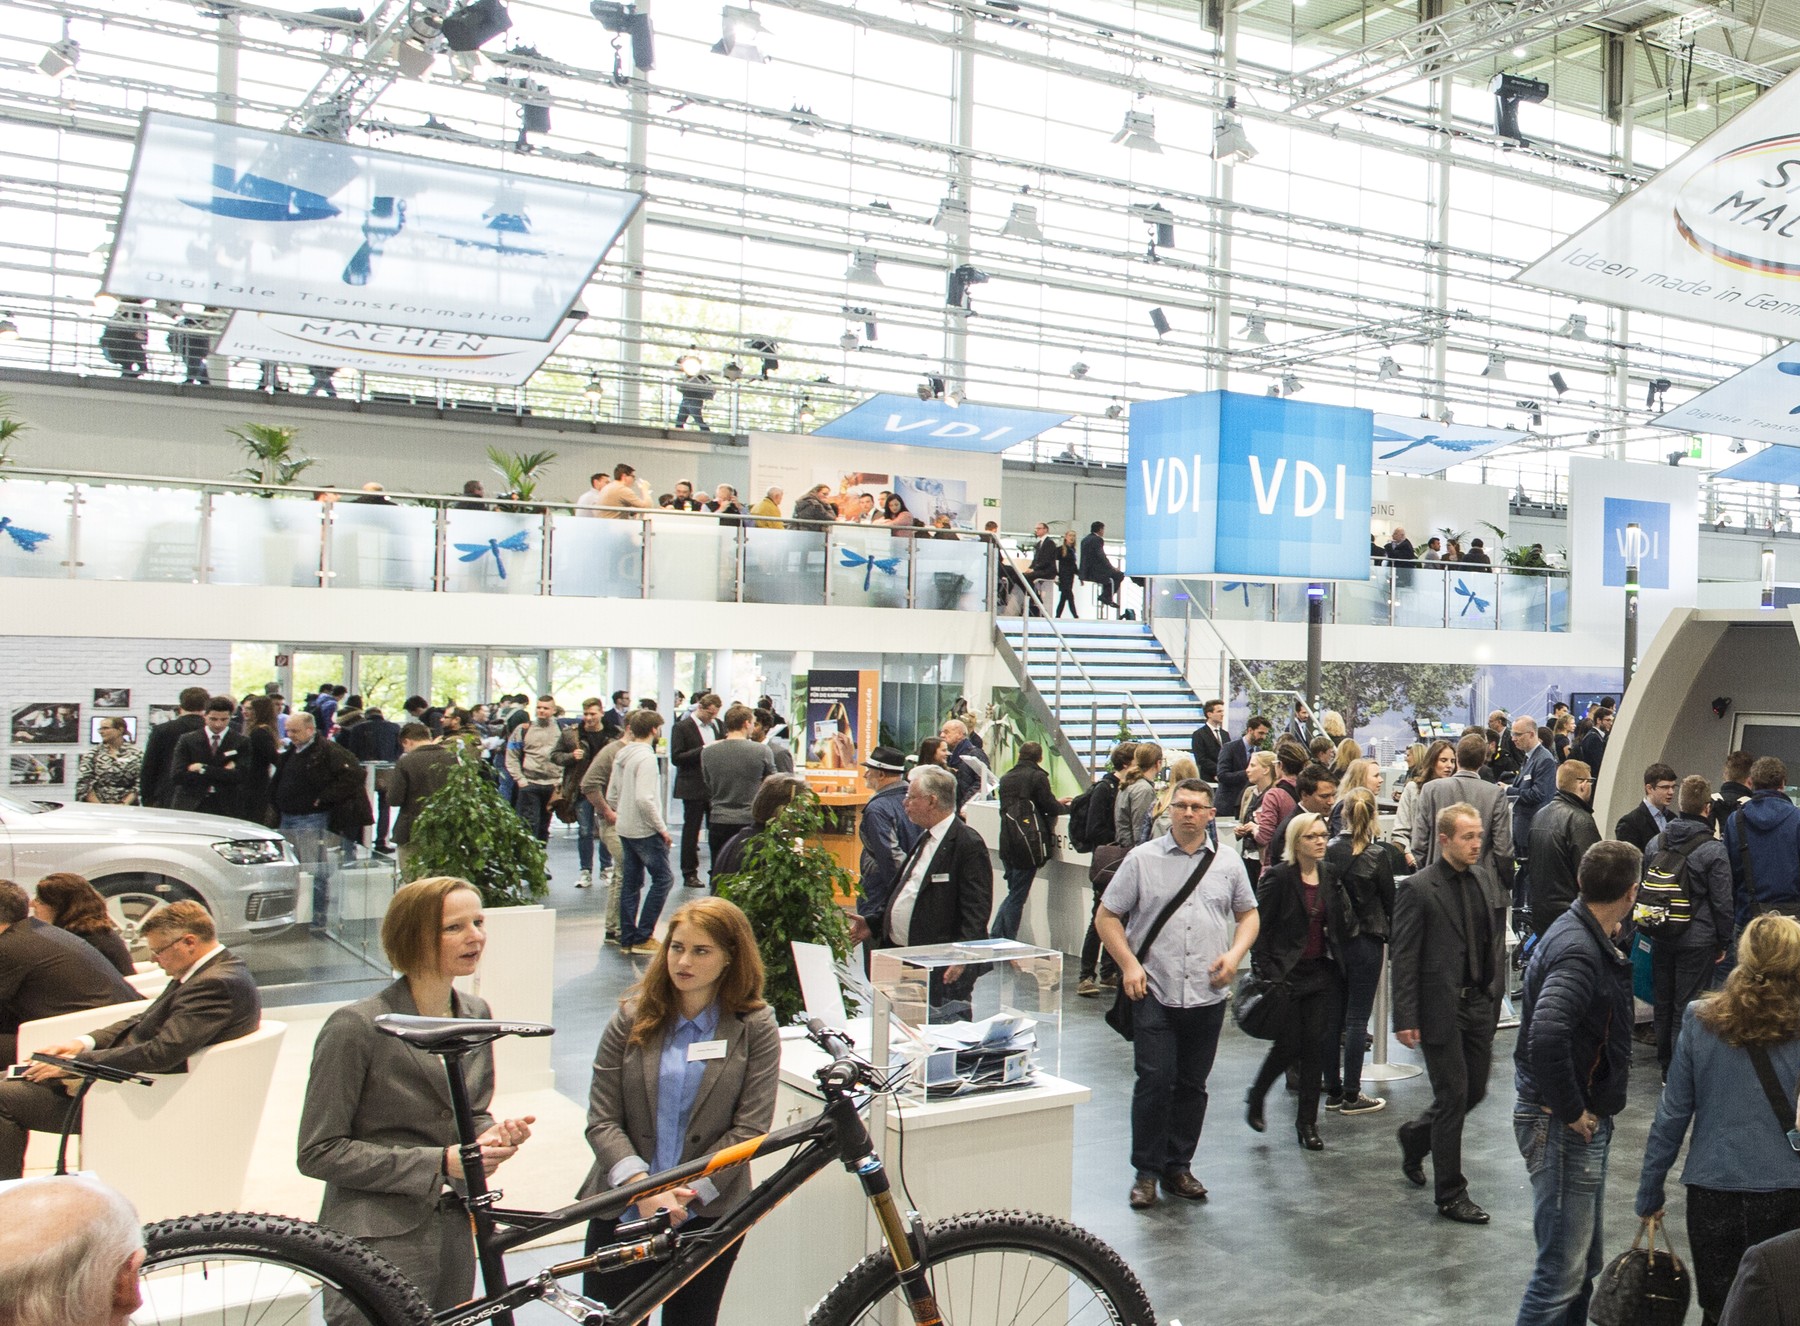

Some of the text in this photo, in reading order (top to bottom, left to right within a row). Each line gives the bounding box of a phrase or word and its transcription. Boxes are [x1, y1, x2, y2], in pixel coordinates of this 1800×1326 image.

[1561, 247, 1638, 279] Ideen
[1641, 272, 1711, 297] made
[1714, 286, 1742, 303] in
[145, 271, 532, 325] Digitale Transformation
[300, 322, 483, 352] MACHEN
[233, 341, 517, 379] Ideen made in Germany
[884, 414, 1014, 441] VDI
[1686, 408, 1742, 425] Digitale
[1142, 454, 1201, 515] VDI
[1248, 455, 1346, 520] VDI
[1616, 528, 1659, 559] VDI
[501, 1025, 541, 1033] ERGON
[452, 1303, 511, 1326] COMSOL
